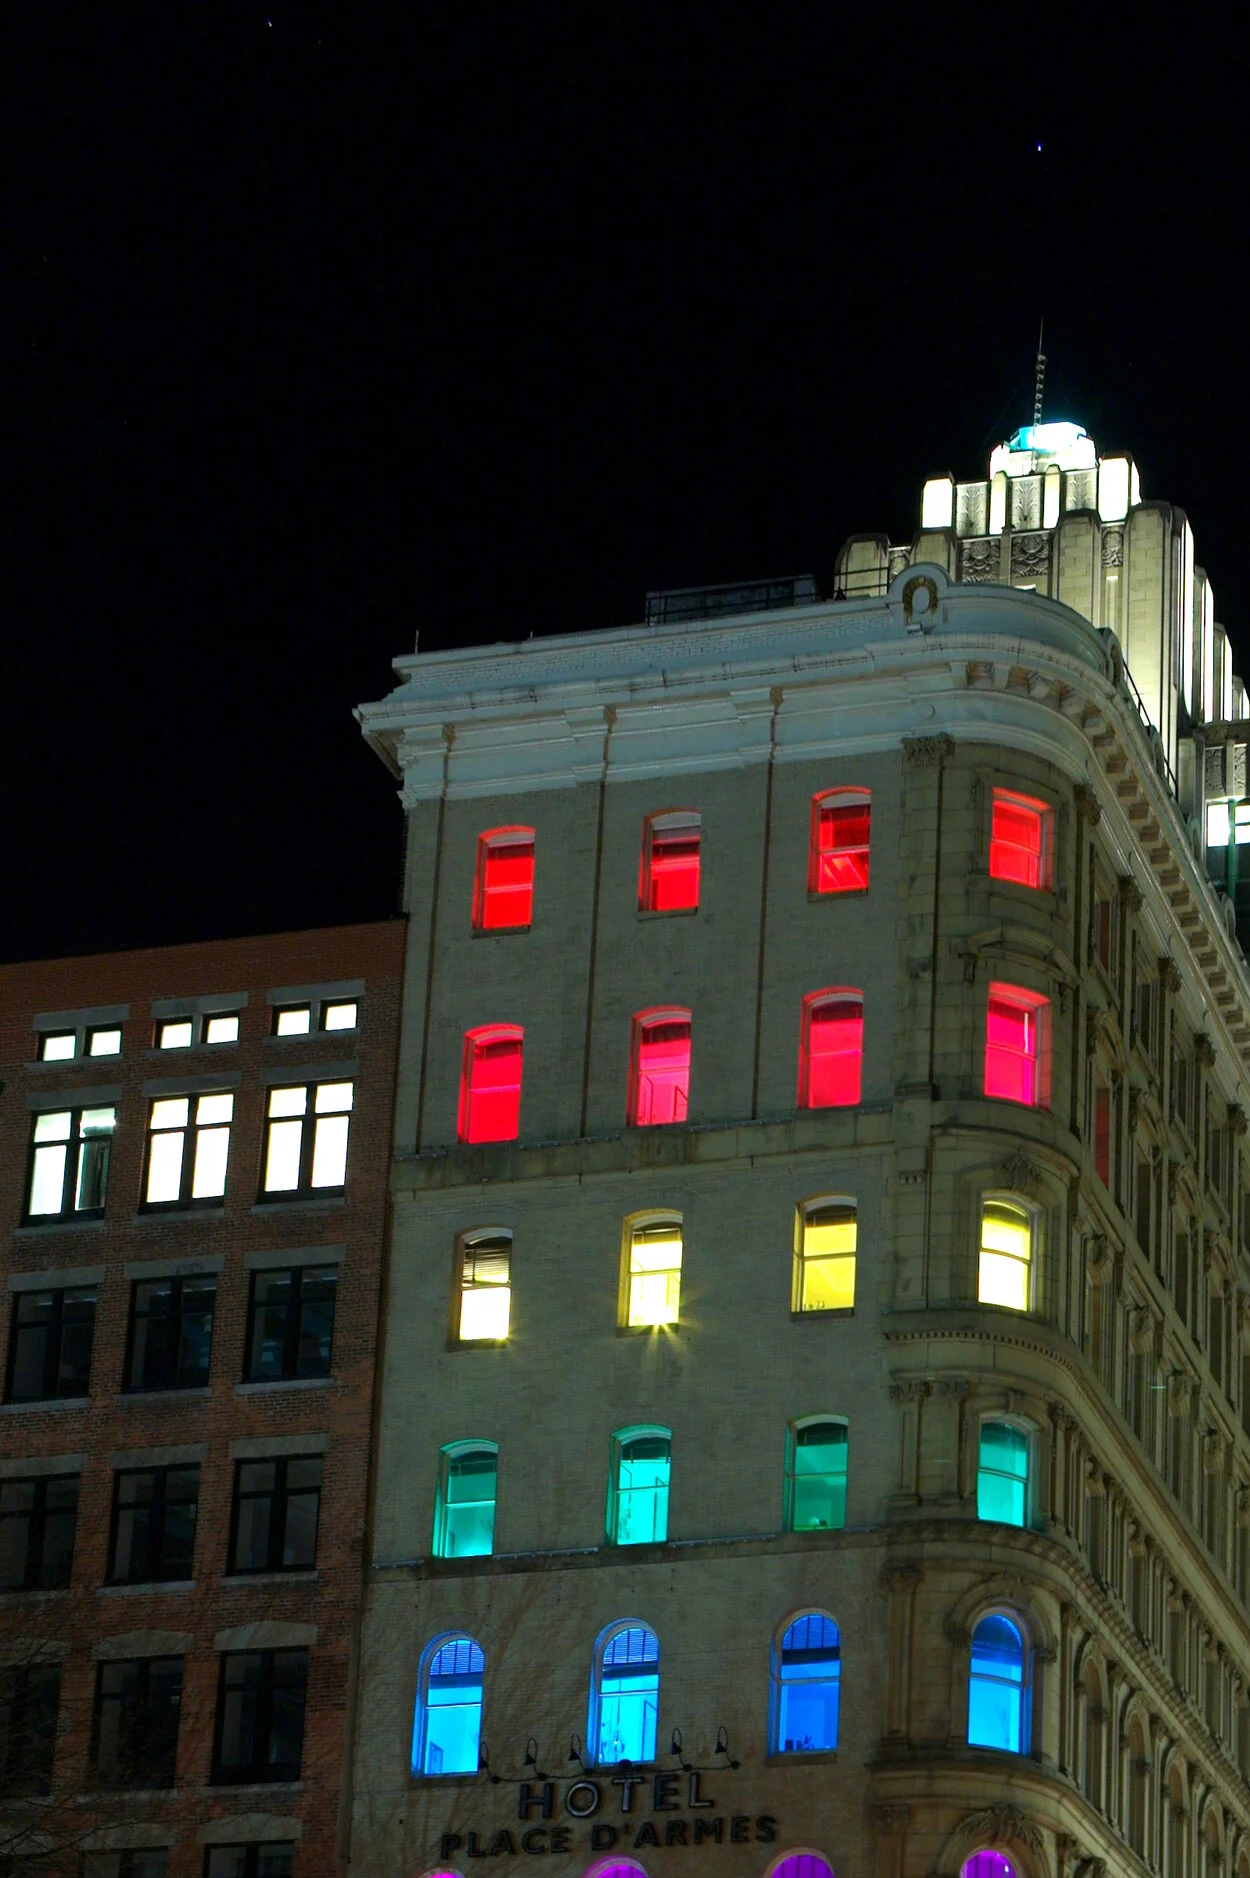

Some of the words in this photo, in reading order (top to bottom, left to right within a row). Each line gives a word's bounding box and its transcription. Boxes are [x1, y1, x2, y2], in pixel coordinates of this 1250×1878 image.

[518, 1773, 714, 1820] HOTEL
[440, 1826, 571, 1861] PLACE
[591, 1815, 777, 1852] D'ARMES
